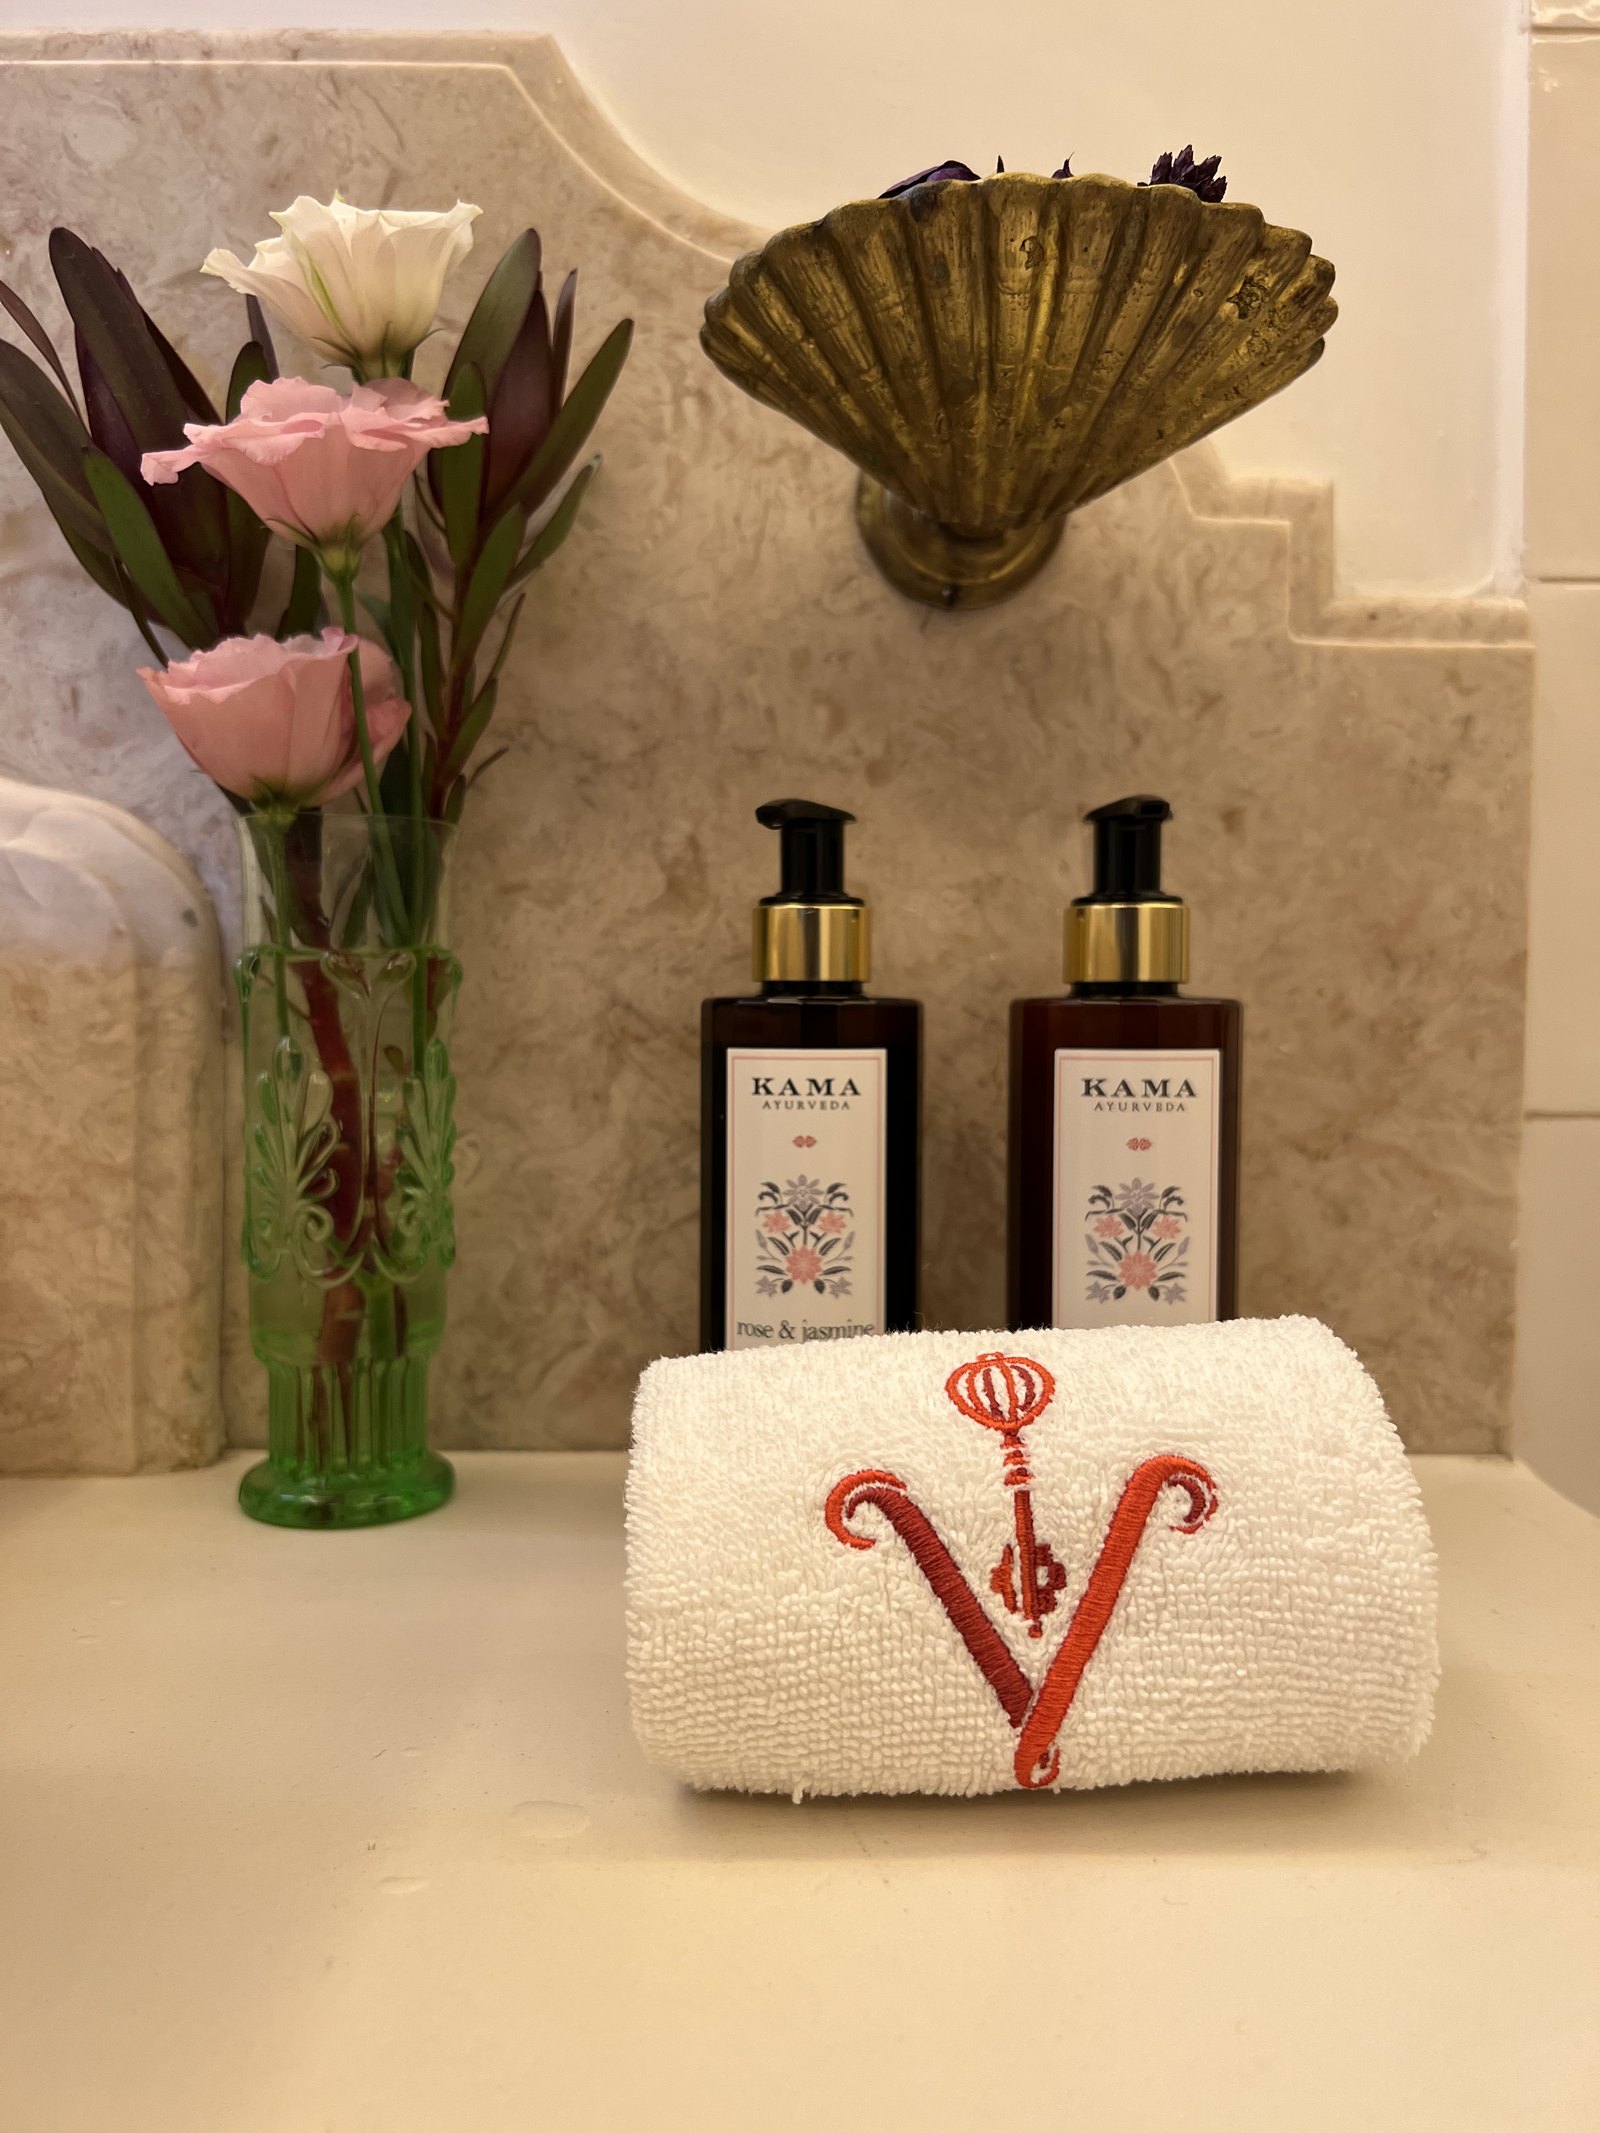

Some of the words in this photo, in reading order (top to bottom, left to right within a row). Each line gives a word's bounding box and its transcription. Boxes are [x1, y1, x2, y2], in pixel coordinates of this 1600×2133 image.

[752, 1077, 861, 1096] KAMA
[1081, 1078, 1196, 1097] KAMA
[762, 1100, 850, 1110] AYURVEDA
[1094, 1102, 1185, 1112] AYURVEDA
[737, 1321, 773, 1338] rose
[778, 1319, 795, 1339] &
[801, 1319, 875, 1342] jasmine
